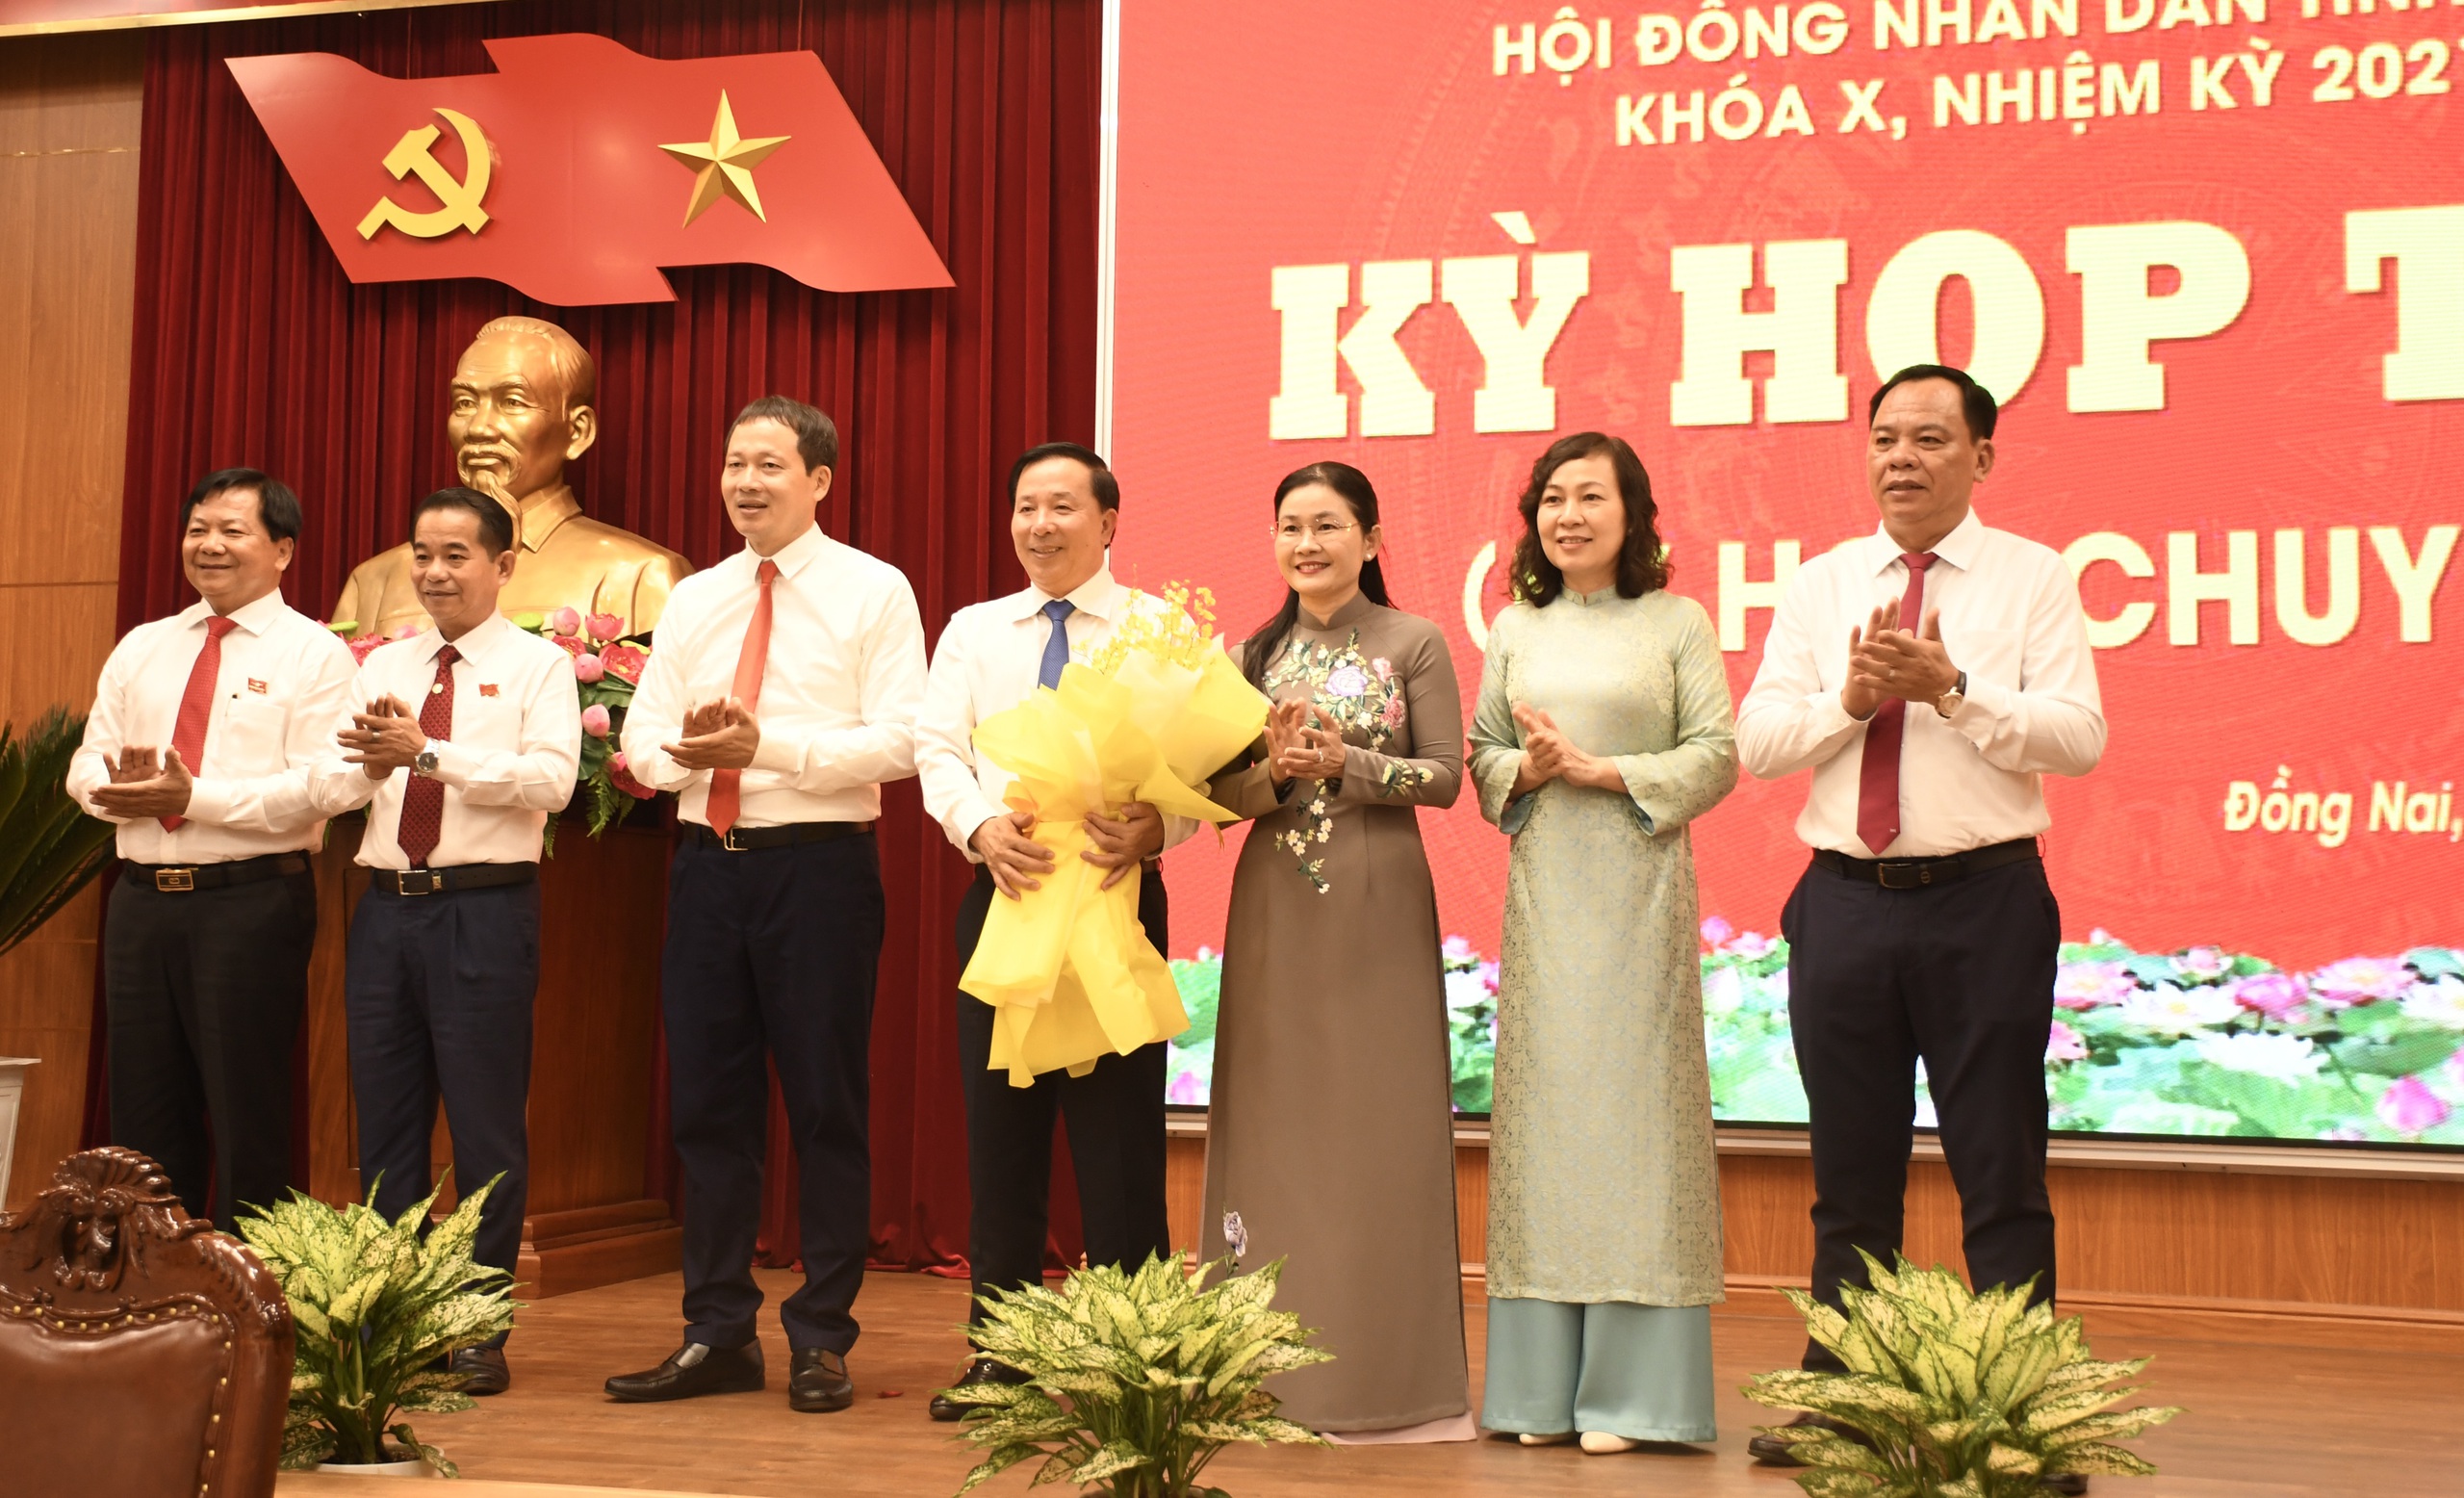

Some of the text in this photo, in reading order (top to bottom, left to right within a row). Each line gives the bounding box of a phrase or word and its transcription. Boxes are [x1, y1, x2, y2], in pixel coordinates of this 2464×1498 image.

[1492, 6, 1612, 88] HỘI
[1615, 37, 2464, 147] KHÓA X, NHIỆM KỲ 202
[1268, 210, 1591, 441] KỲ
[2222, 763, 2463, 849] Đồng Nai,
